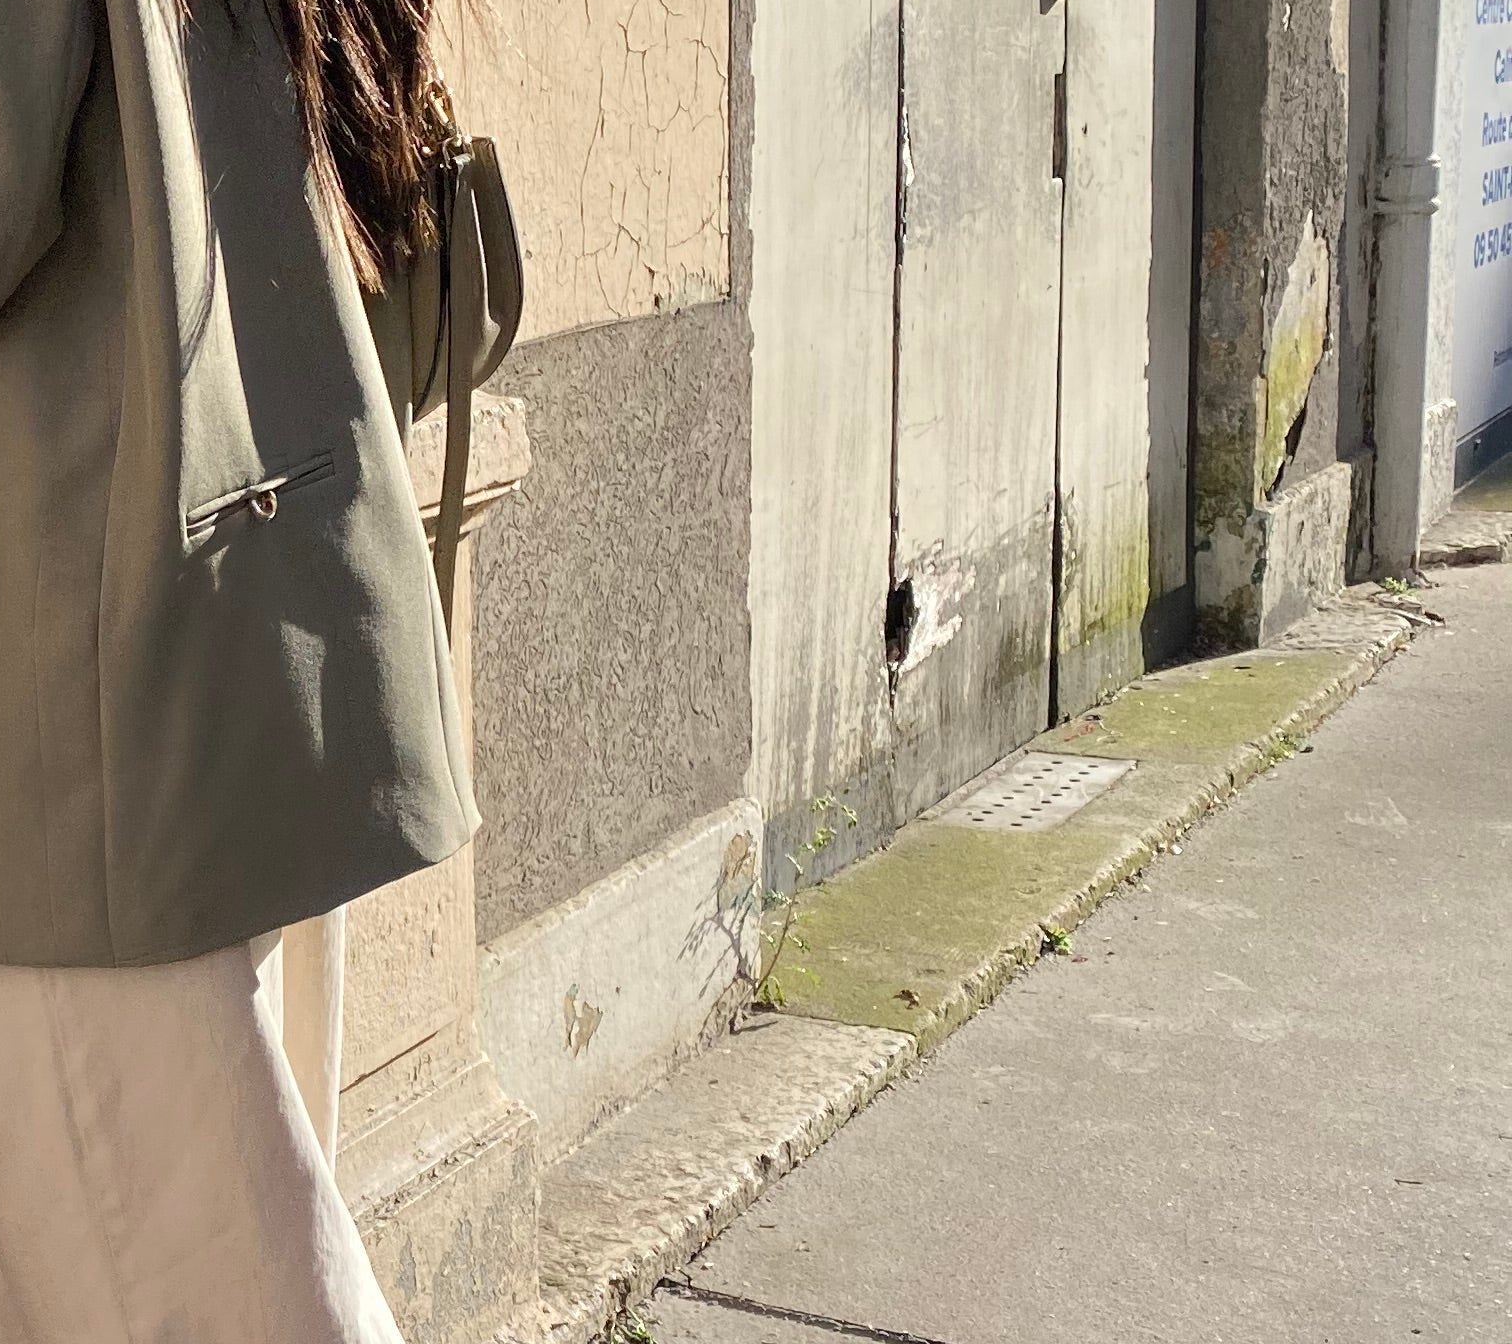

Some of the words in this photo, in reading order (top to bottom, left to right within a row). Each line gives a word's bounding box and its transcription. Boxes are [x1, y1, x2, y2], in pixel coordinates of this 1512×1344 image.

[1482, 112, 1507, 146] Route
[1482, 166, 1512, 207] SAINT-
[1474, 232, 1486, 269] 09
[1487, 227, 1499, 263] 50
